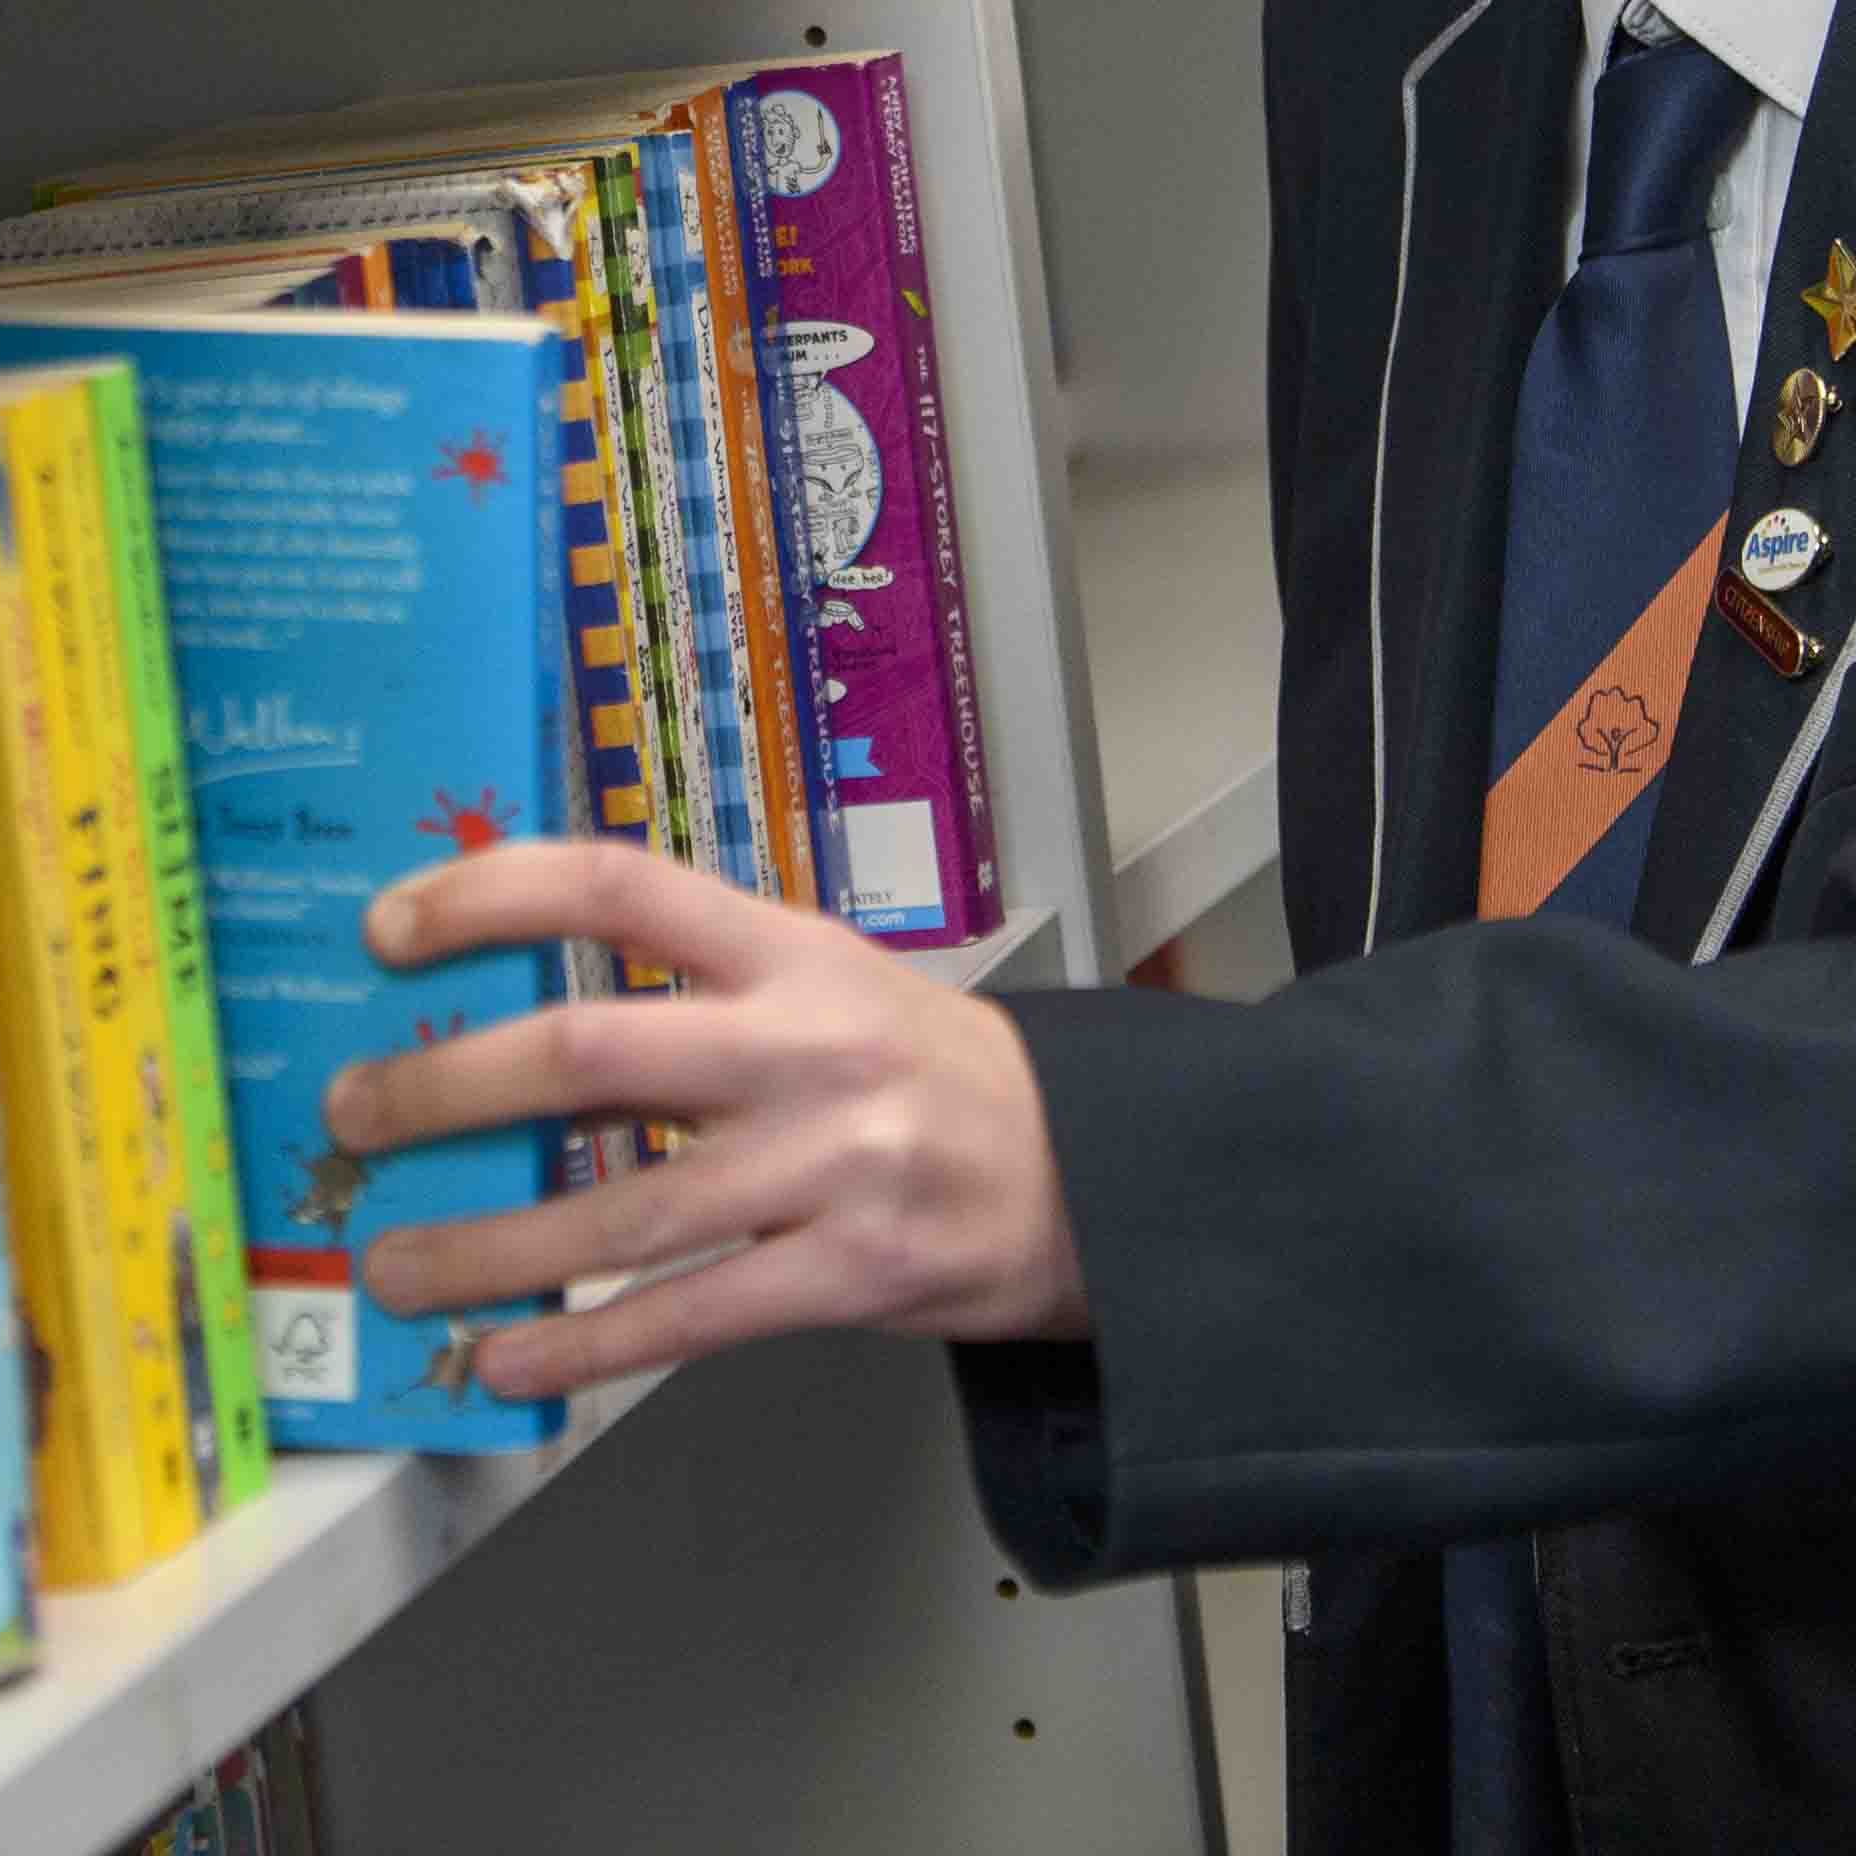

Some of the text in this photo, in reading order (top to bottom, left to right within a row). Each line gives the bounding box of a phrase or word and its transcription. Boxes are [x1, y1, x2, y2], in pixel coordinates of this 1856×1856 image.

[698, 304, 714, 382] Diary
[713, 436, 730, 523] Wimpy
[724, 529, 736, 574] Kid
[1746, 530, 1809, 565] Aspire
[919, 394, 958, 589] 117-STOREY
[947, 606, 986, 819] TREEHOUSE
[806, 623, 842, 835] TREEHOUSE
